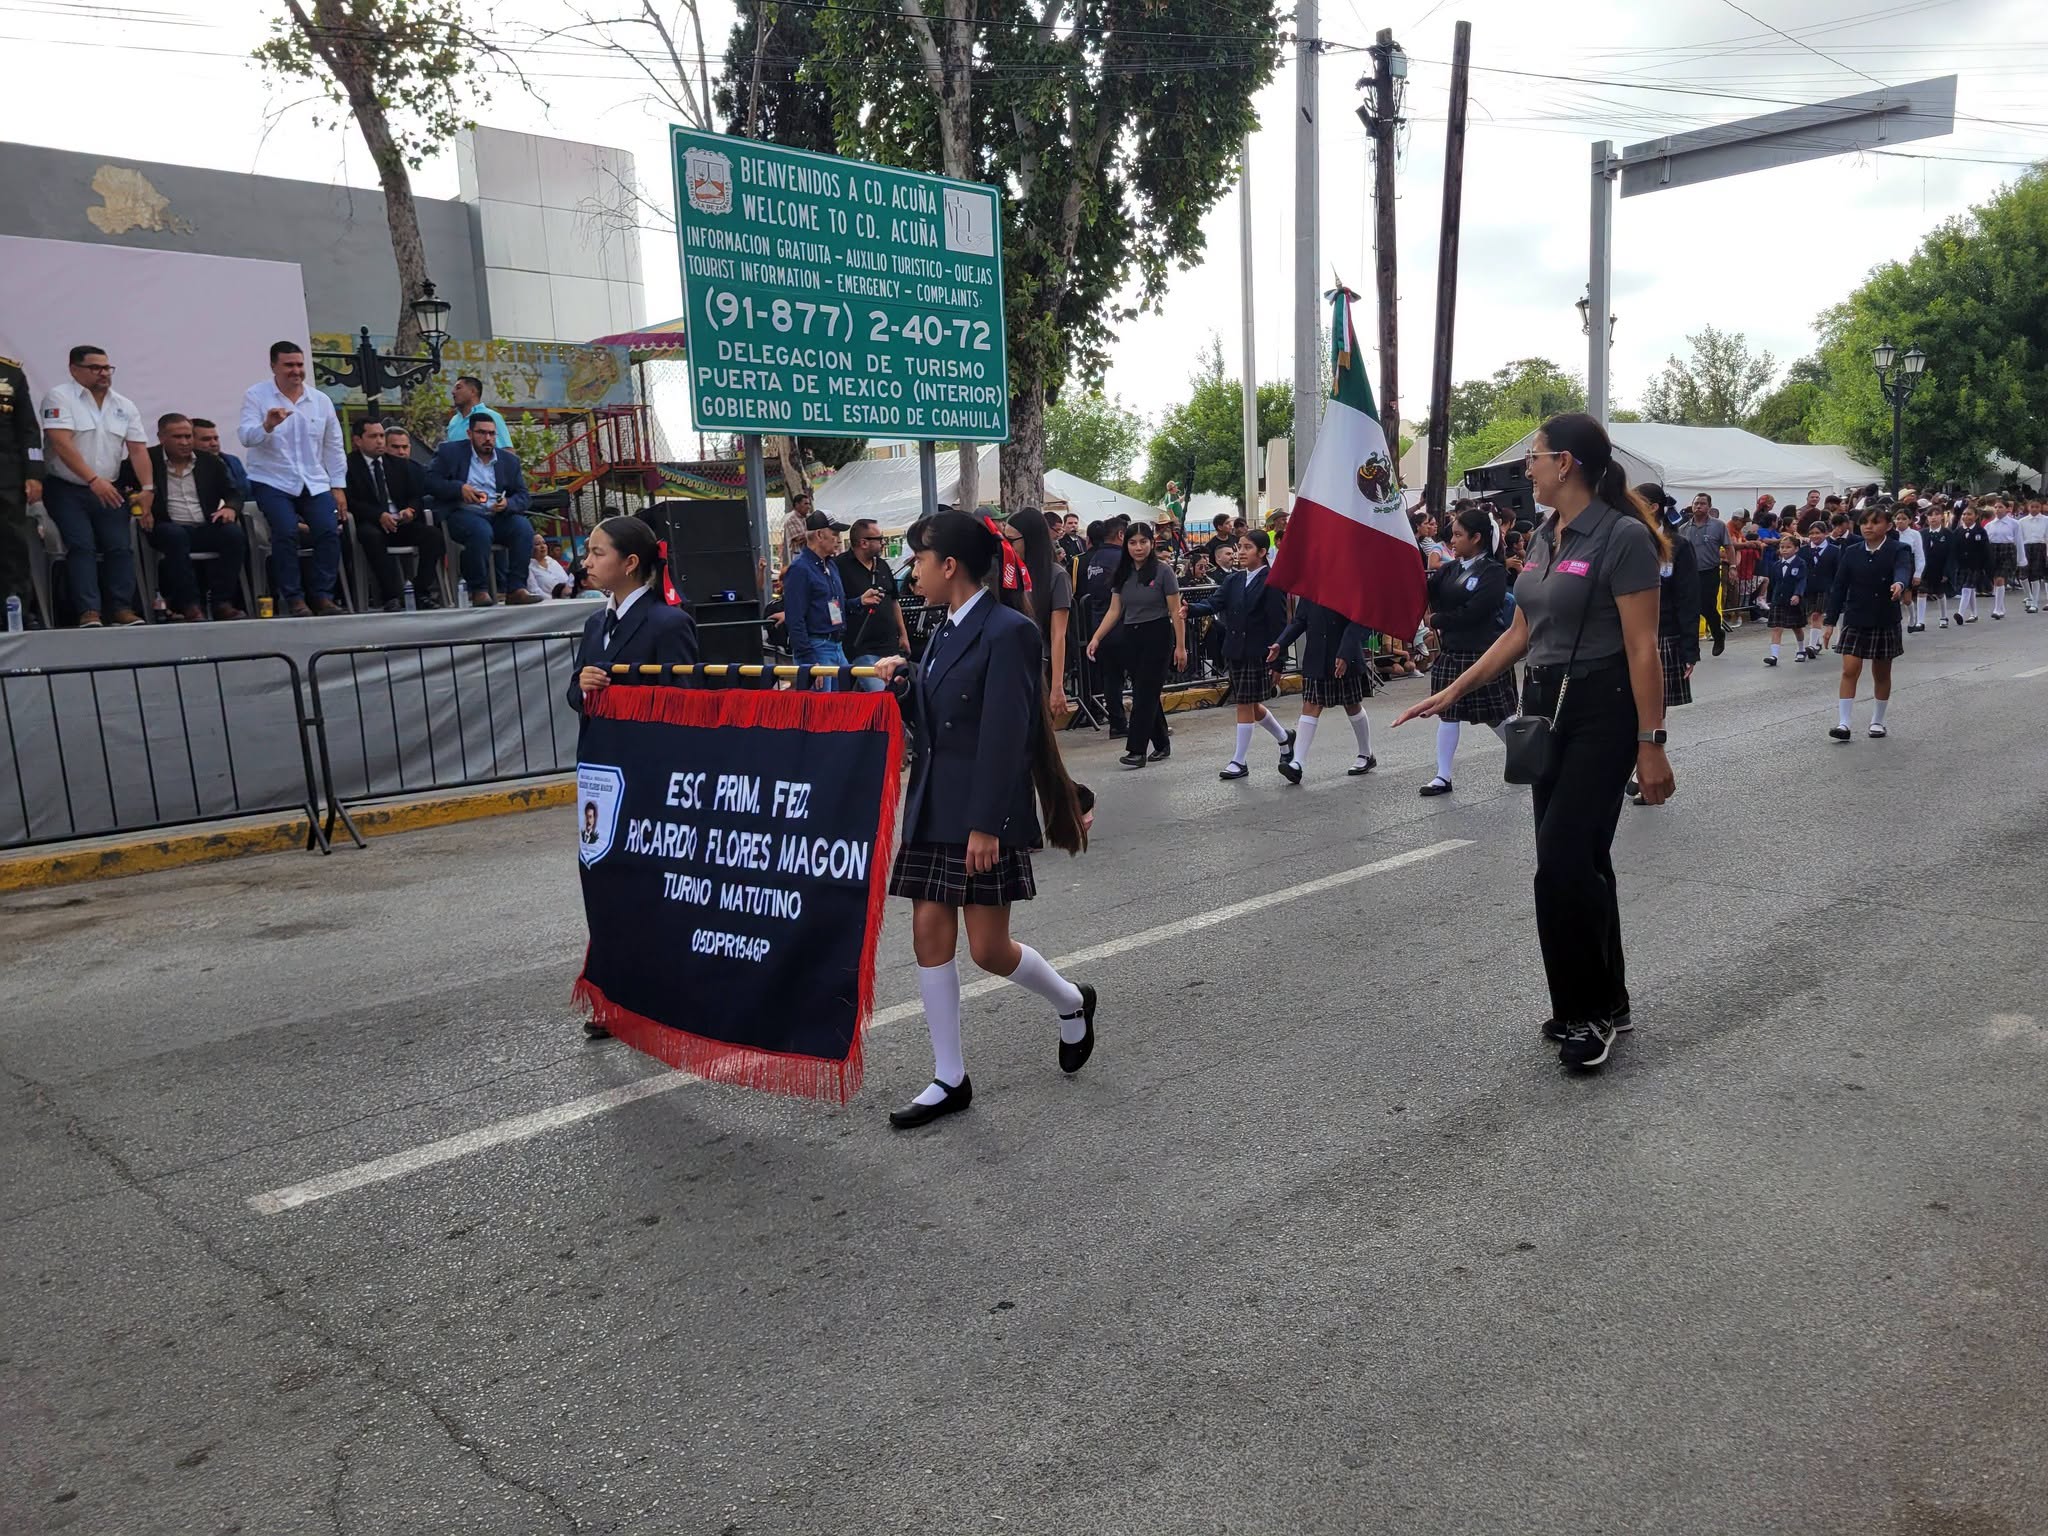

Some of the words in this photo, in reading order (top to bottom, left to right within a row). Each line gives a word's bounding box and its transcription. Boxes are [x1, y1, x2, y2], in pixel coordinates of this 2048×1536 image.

[741, 157, 841, 199] BIENVENIDOS
[849, 176, 859, 202] A
[864, 180, 887, 207] CD.
[891, 184, 937, 215] ACUÑA
[741, 193, 820, 231] WELCOME
[828, 208, 847, 235] TO
[856, 213, 880, 240] CD.
[891, 218, 939, 248] ACUÑA
[686, 225, 771, 257] INFORMACION
[777, 238, 832, 265] GRATUITA
[846, 249, 887, 272] AUXILIO
[891, 255, 942, 279] TURISTICO
[954, 264, 993, 286] QUEJAS
[687, 254, 735, 280] TOURIST
[741, 261, 821, 290] INFORMATION
[837, 274, 900, 299] EMERGENCY
[705, 286, 853, 343] (91-877)
[869, 310, 991, 351] 2-40-72
[718, 340, 852, 371] DELEGACION
[867, 354, 893, 374] DE
[904, 357, 985, 379] TURISMO
[698, 367, 783, 392] PUERTA
[792, 374, 820, 394] DE
[828, 376, 903, 399] MEXICO
[913, 379, 1003, 408] (INTERIOR)
[702, 396, 791, 420] GOBIERNO
[802, 403, 833, 422] DEL
[843, 405, 900, 425] ESTADO
[906, 407, 925, 426] DE
[932, 408, 1001, 429] COAHUILA
[666, 772, 707, 810] ESC
[713, 775, 761, 814] PRIM.
[772, 780, 811, 819] FED.
[624, 818, 698, 861] RICARDO
[705, 828, 772, 871] FLORES
[777, 834, 869, 881] MAGON
[664, 872, 712, 906] TURNO
[719, 882, 802, 920] MATUTINO
[692, 928, 771, 963] 05DPR1546P
